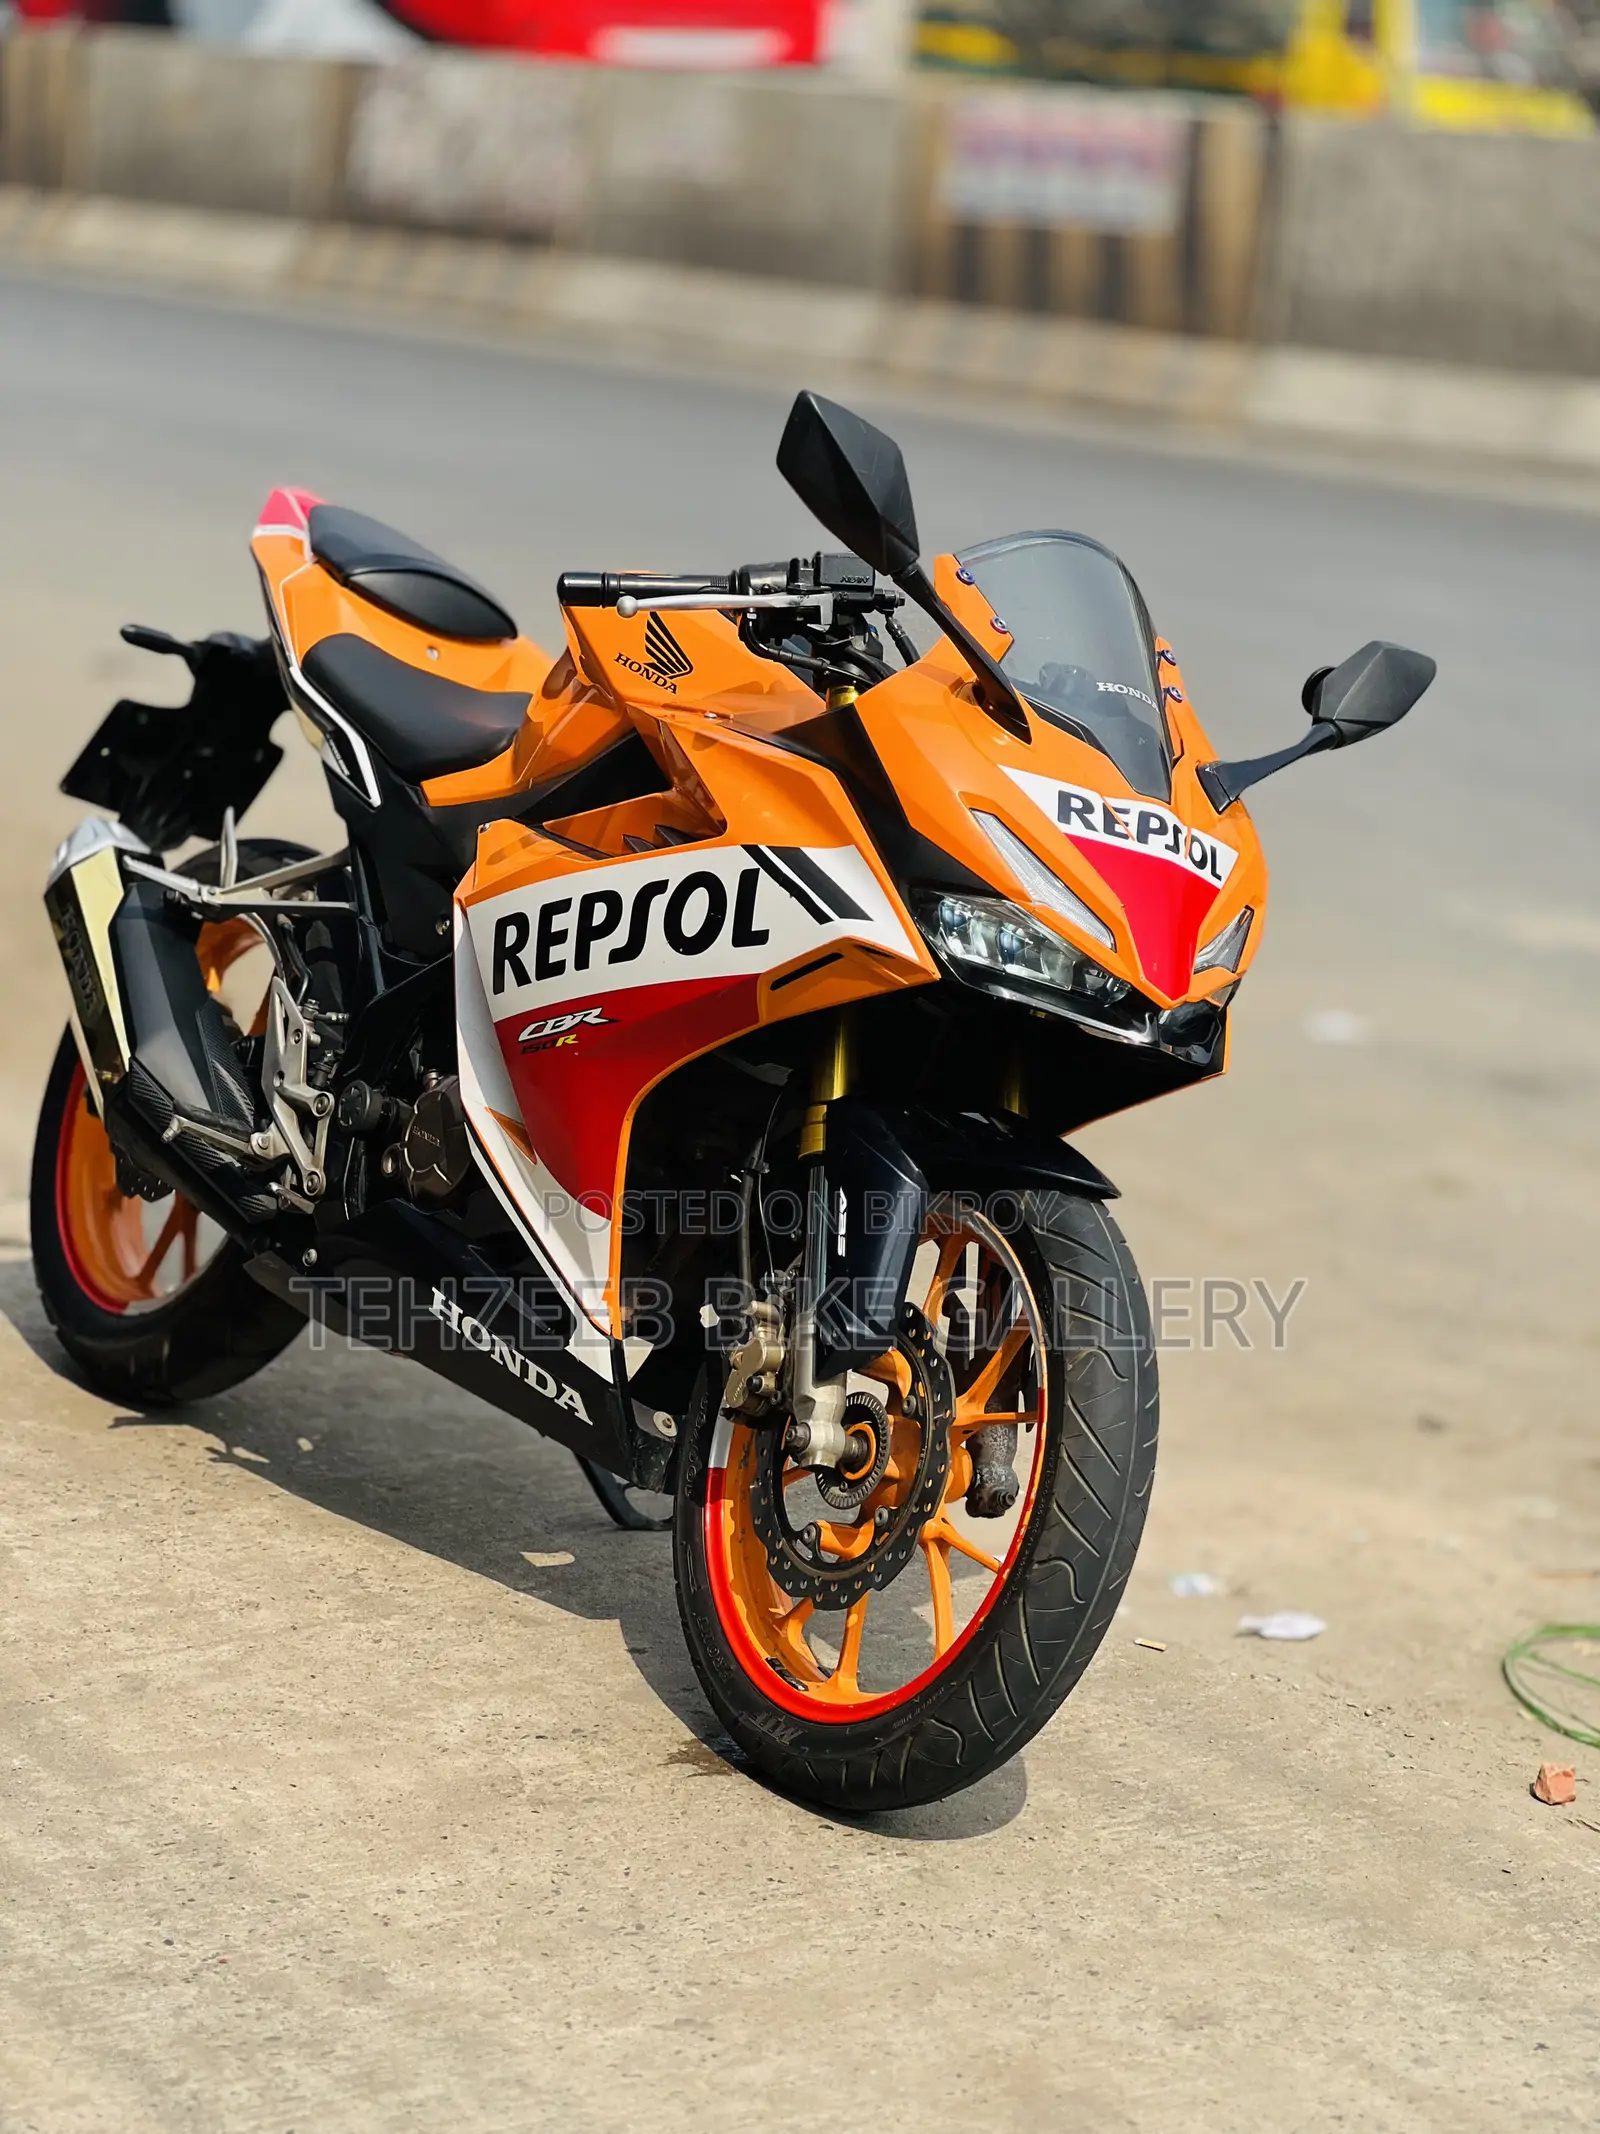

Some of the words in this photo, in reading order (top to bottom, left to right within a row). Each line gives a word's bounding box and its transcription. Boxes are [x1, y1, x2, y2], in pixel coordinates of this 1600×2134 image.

[613, 652, 678, 695] HONDA
[1096, 681, 1160, 714] HONDA
[1057, 789, 1223, 882] REPSOL
[492, 867, 772, 995] REPSOL
[517, 1007, 612, 1042] CBR
[520, 1034, 579, 1055] 150R
[428, 1286, 594, 1427] HONDA
